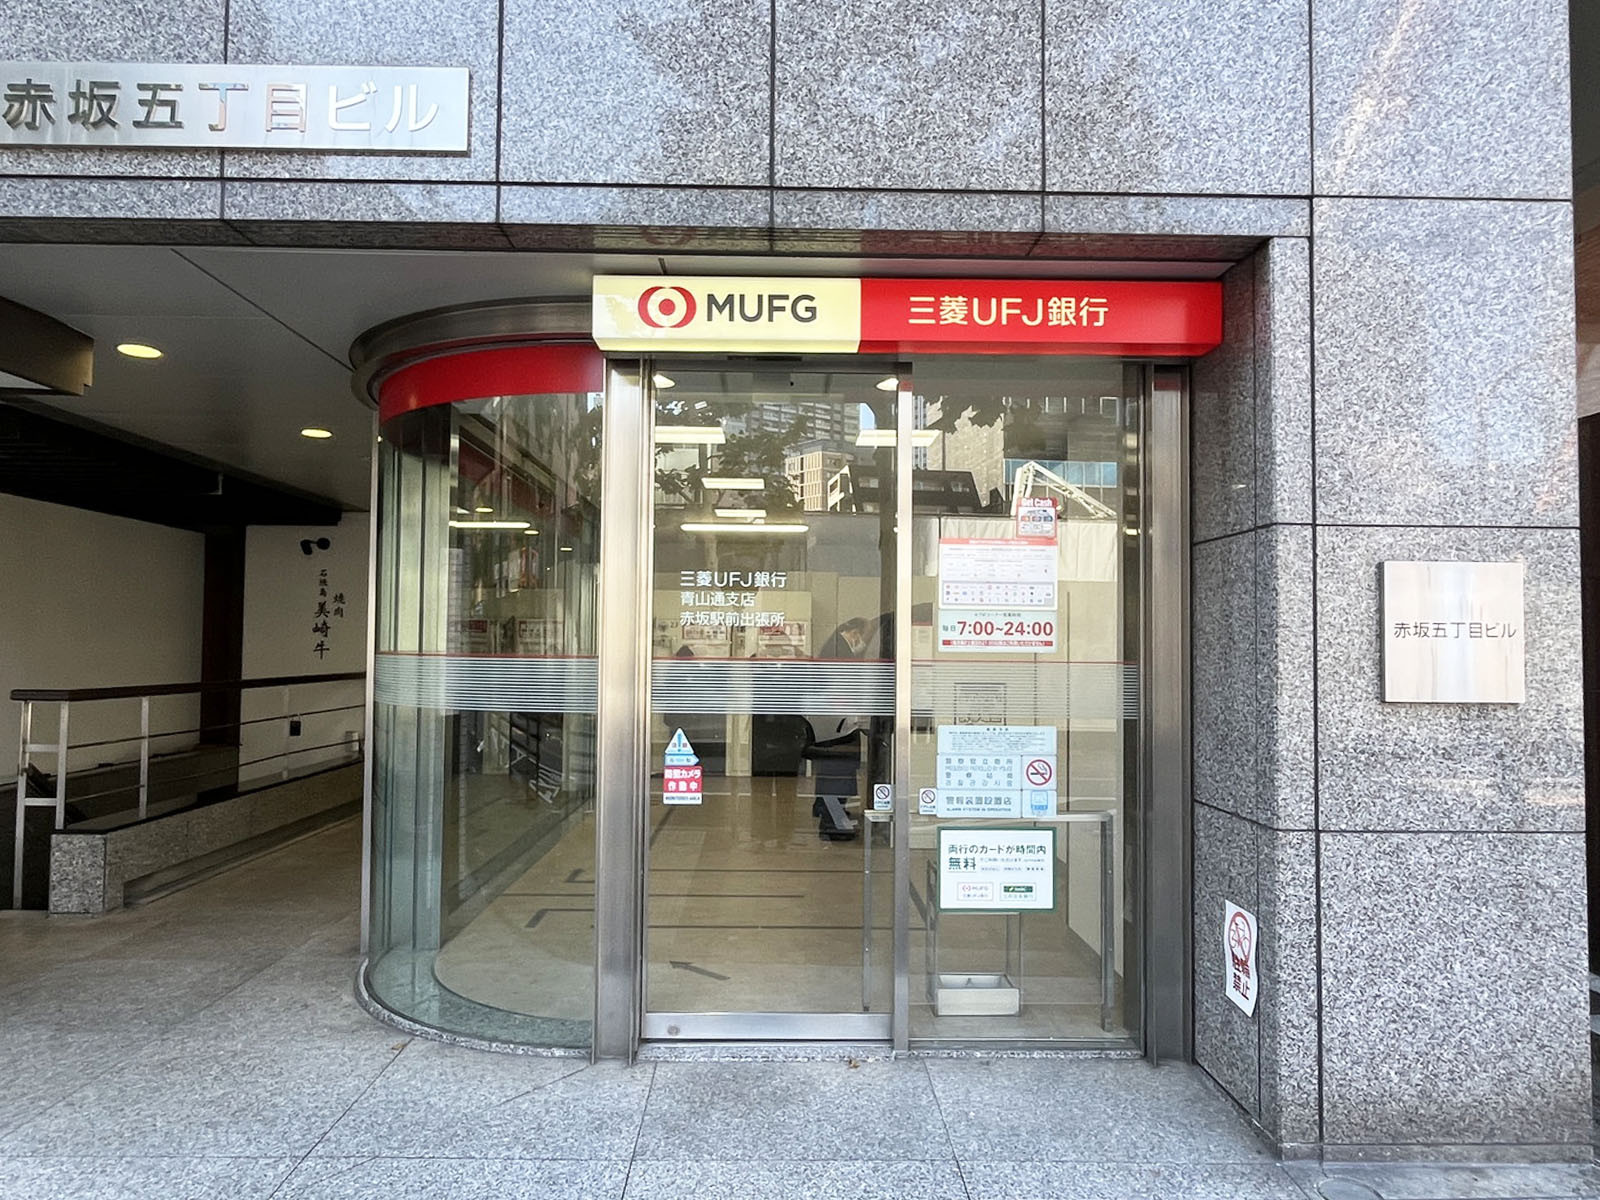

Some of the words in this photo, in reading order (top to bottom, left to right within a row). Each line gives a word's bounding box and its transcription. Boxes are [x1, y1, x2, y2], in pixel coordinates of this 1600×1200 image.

[2, 78, 440, 132] 赤坂五丁目ビル
[706, 293, 818, 323] MUFG
[908, 296, 1109, 327] 三菱UFJ銀行
[680, 570, 787, 588] 三菱UFJ銀行
[680, 591, 756, 607] 青山通支店
[680, 611, 785, 627] 赤坂駅前出張所
[1393, 621, 1517, 639] 赤坂五丁目ビル
[948, 857, 977, 870] 無料
